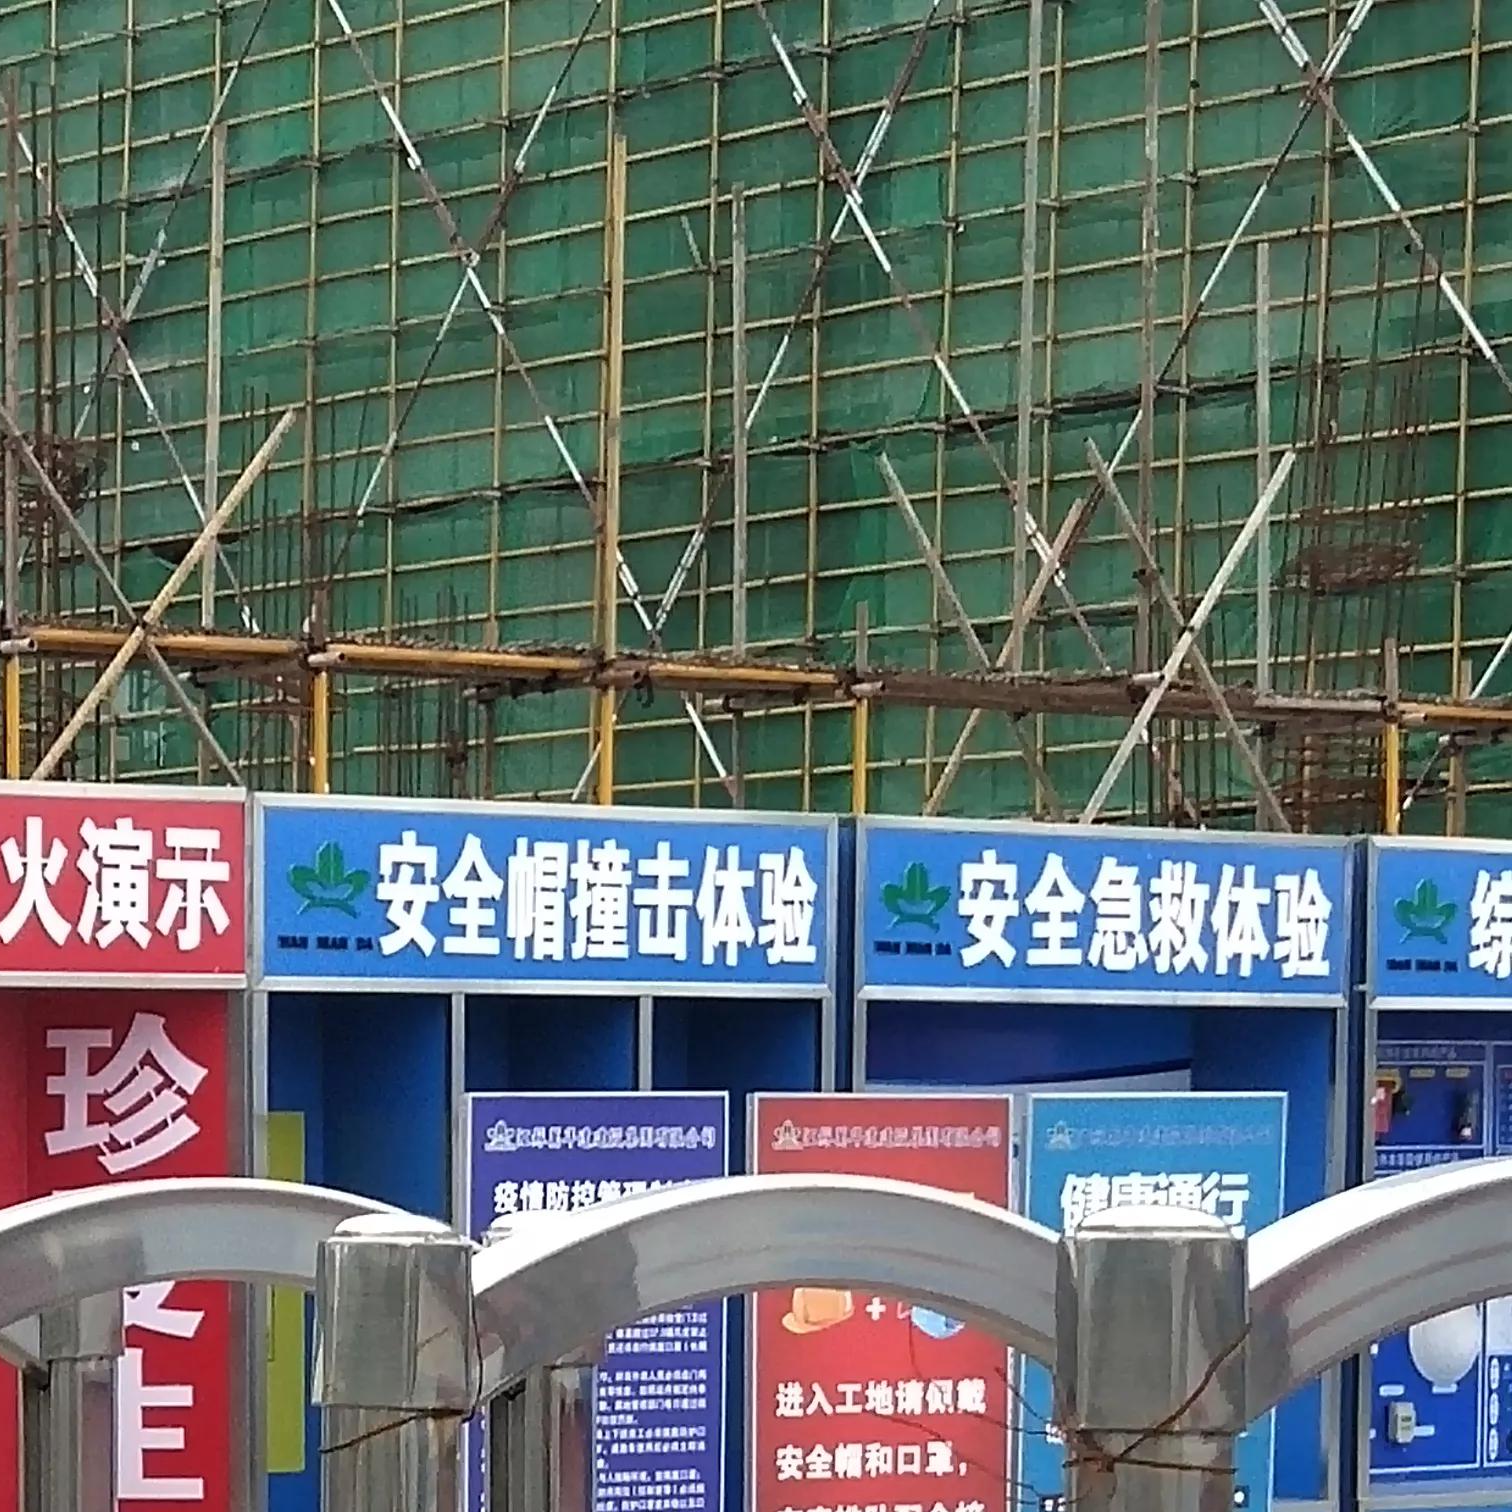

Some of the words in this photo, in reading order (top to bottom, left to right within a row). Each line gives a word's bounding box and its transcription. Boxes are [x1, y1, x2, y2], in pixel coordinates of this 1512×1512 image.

[376, 829, 819, 967] 安全帽撞击体验
[958, 849, 1334, 978] 安全急救体验
[775, 1377, 987, 1417] 进入工地请佩戴
